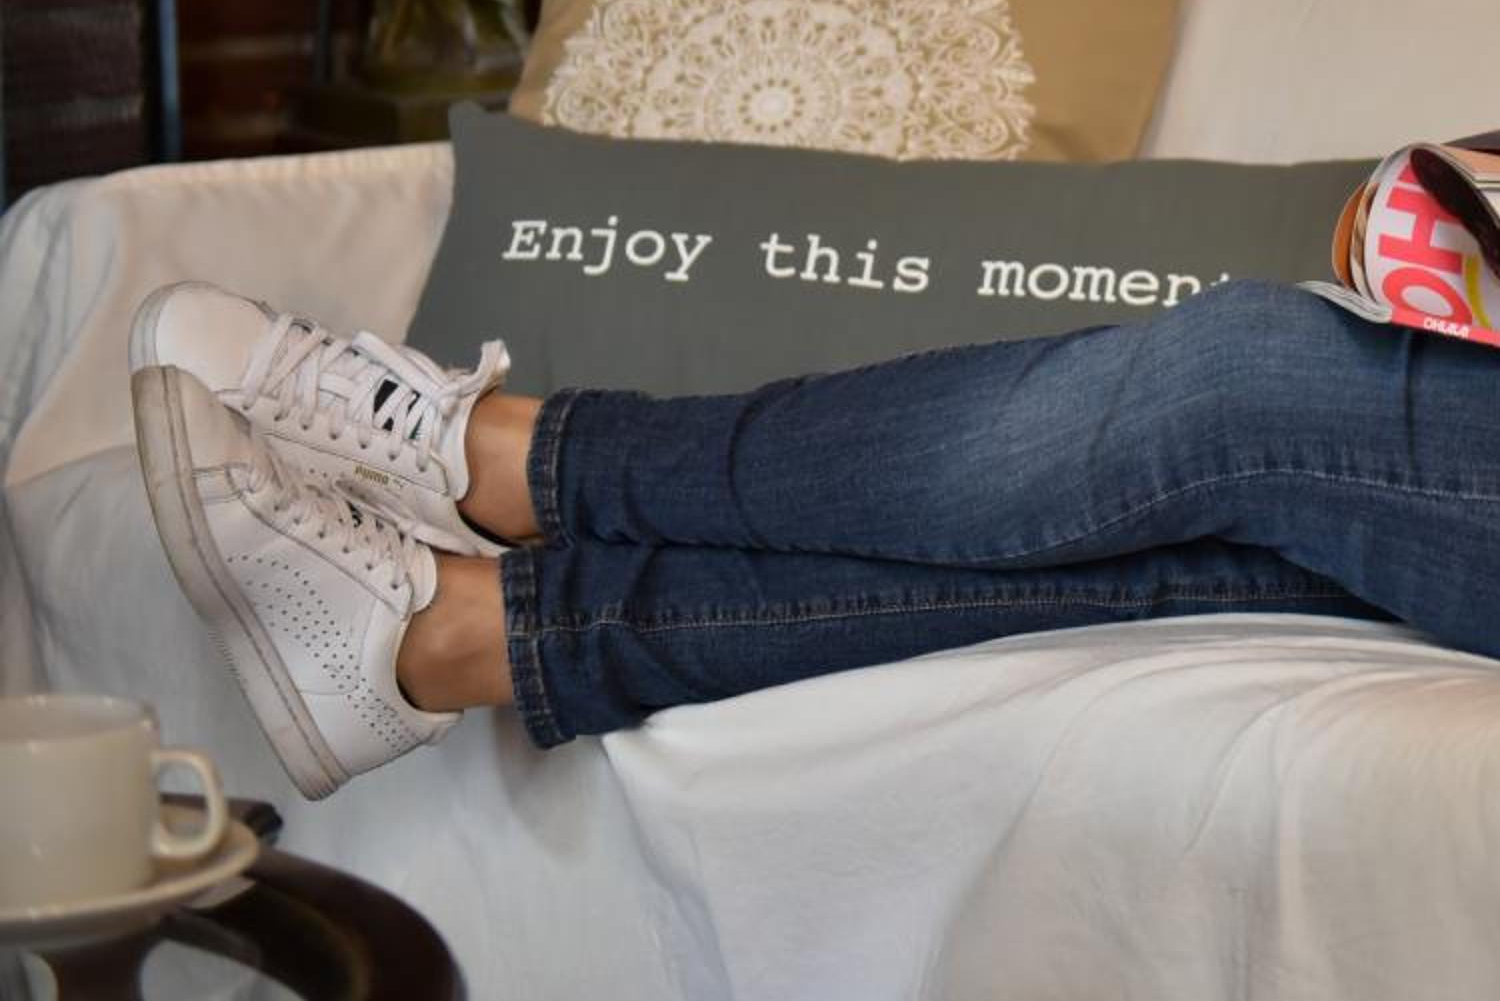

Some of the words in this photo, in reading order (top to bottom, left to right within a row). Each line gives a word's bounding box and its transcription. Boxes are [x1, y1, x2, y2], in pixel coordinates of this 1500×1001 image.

[501, 215, 713, 282] Enjoy
[759, 232, 930, 293] this
[977, 260, 1230, 308] momen
